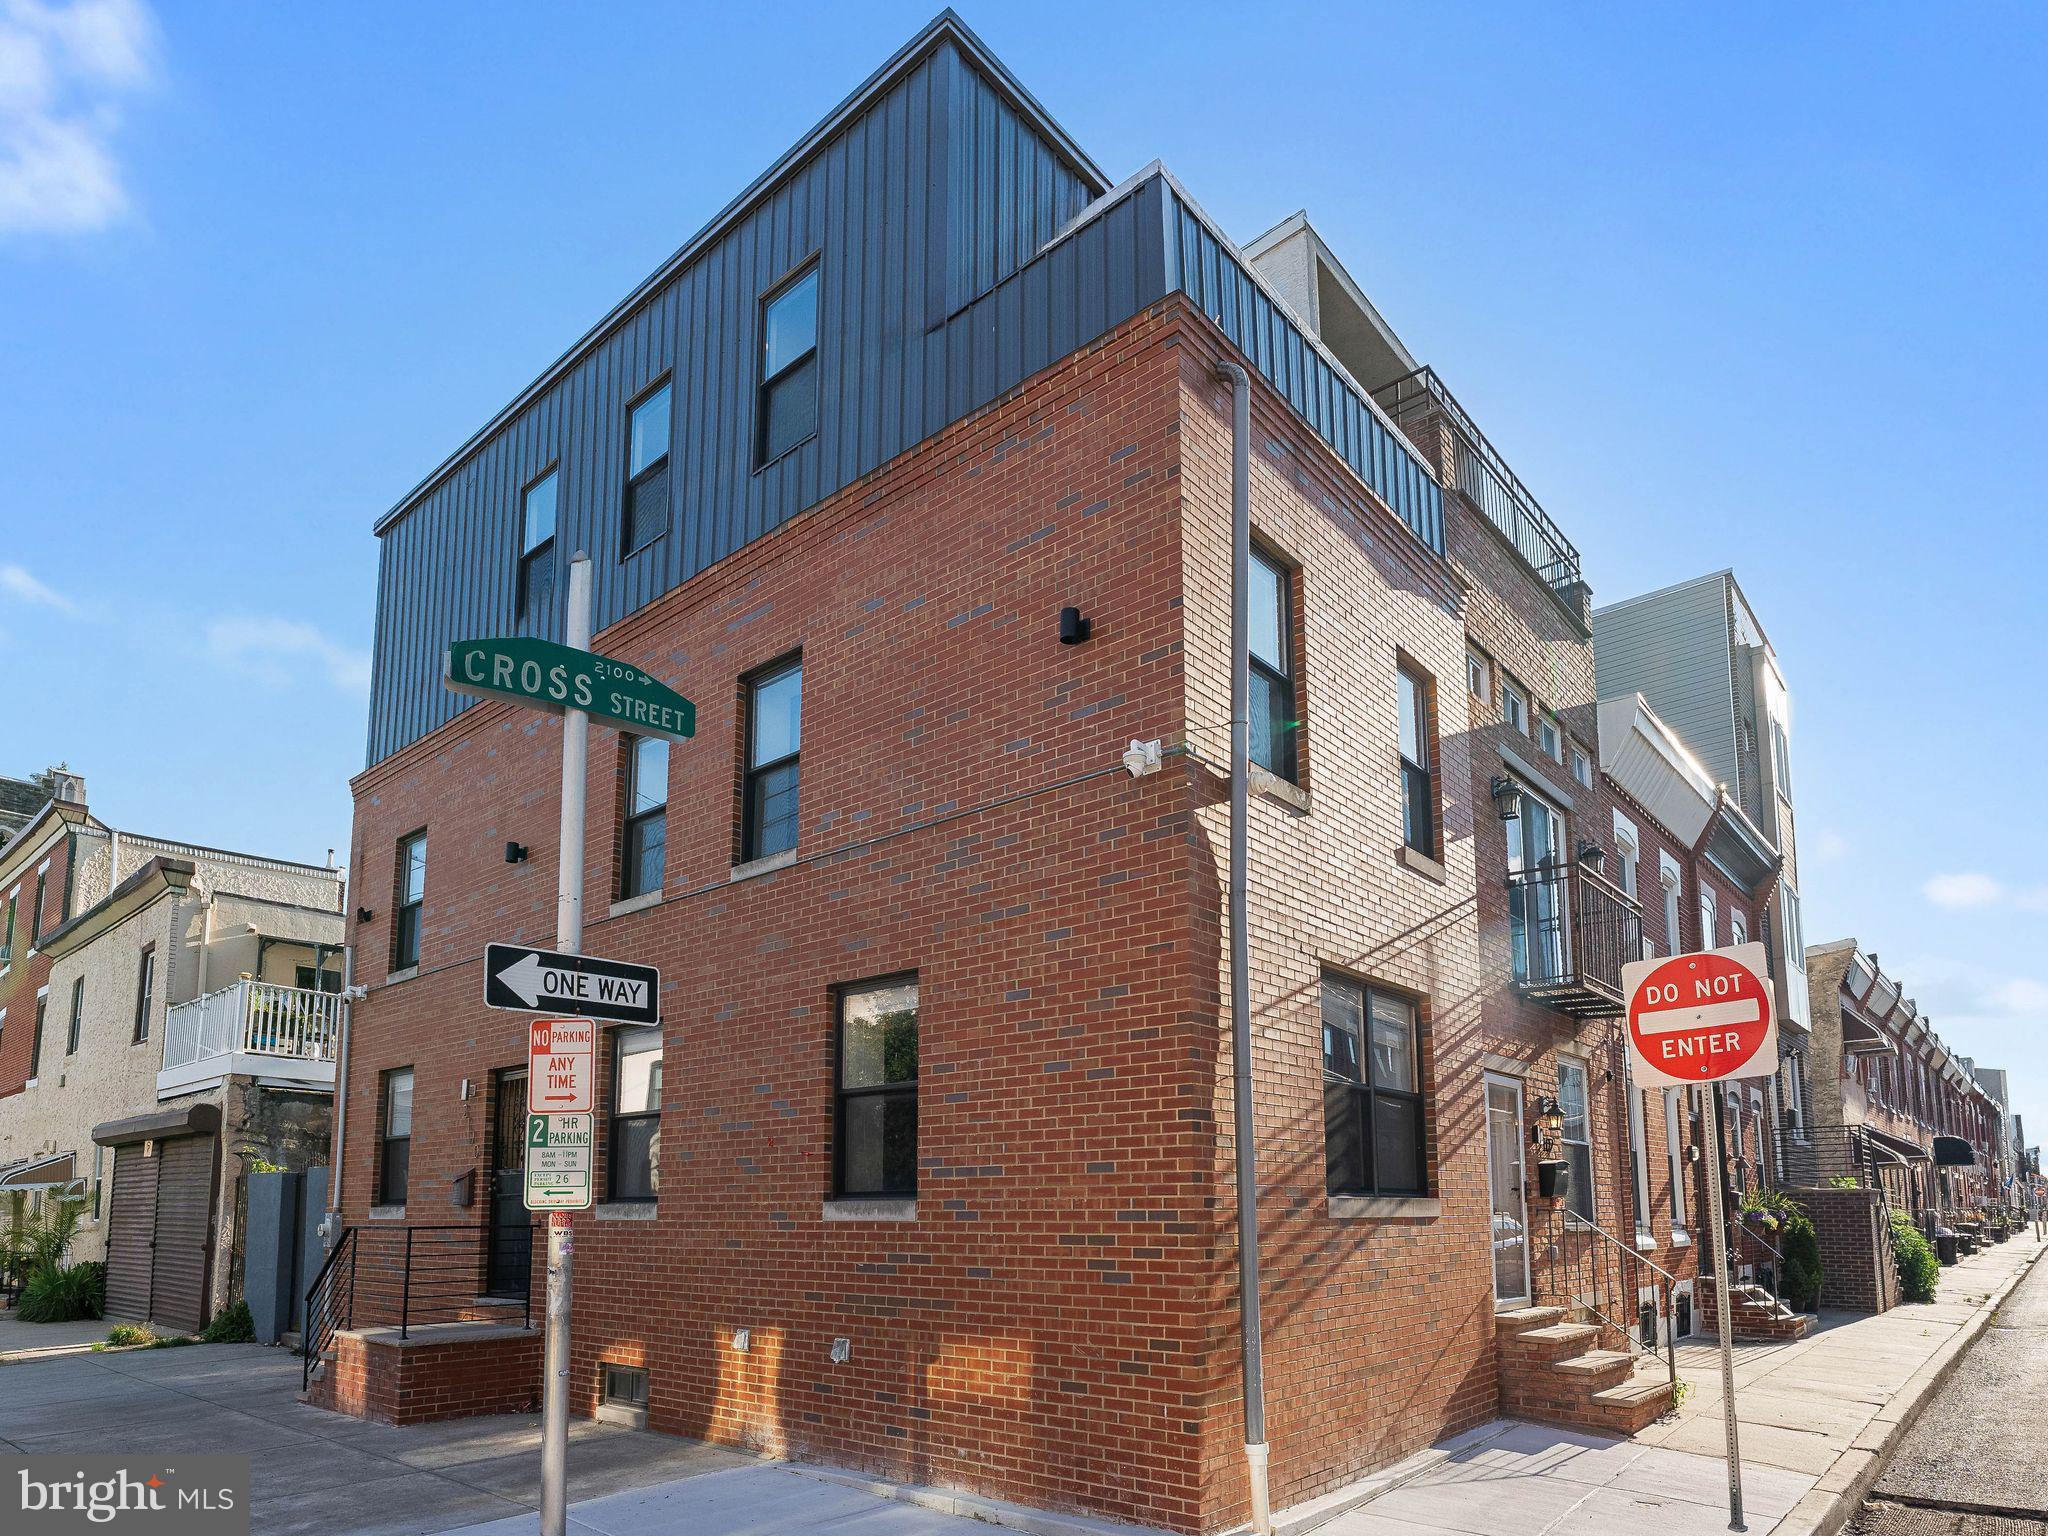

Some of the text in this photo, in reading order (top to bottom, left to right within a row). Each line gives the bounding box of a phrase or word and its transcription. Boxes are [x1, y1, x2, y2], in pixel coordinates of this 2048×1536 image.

[594, 661, 634, 681] 2100
[464, 650, 685, 731] CROSS STREET
[543, 970, 642, 1004] ONE WAY
[1646, 973, 1743, 1005] DO NOT
[533, 1029, 591, 1047] NO PARKING
[1661, 1032, 1741, 1059] ENTER
[548, 1057, 576, 1071] ANY
[547, 1074, 577, 1089] TIME
[532, 1117, 579, 1143] 2 HR
[549, 1132, 589, 1144] PARKING
